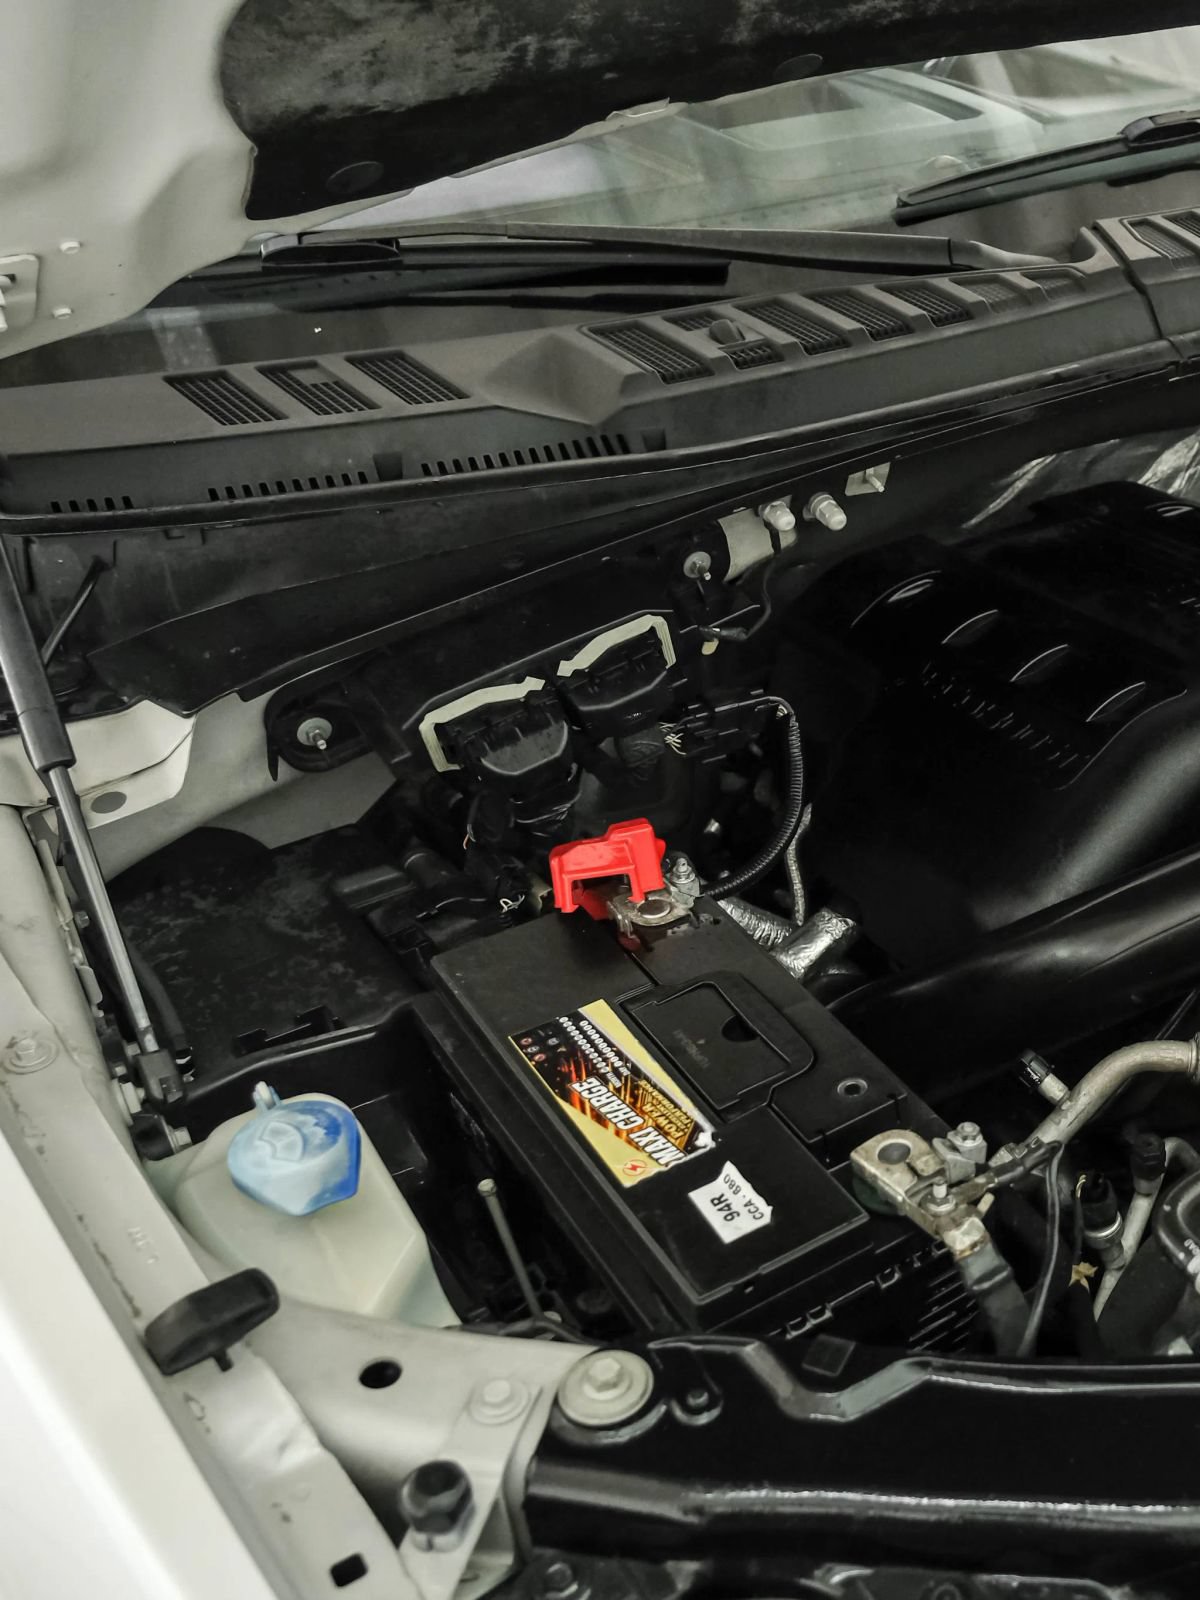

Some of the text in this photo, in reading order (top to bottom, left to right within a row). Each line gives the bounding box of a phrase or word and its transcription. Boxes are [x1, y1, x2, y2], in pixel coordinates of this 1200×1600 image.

[572, 1076, 687, 1166] MAXI CHARGE
[642, 1102, 685, 1140] POWER
[709, 1192, 742, 1224] 94R
[747, 1198, 765, 1221] CCA
